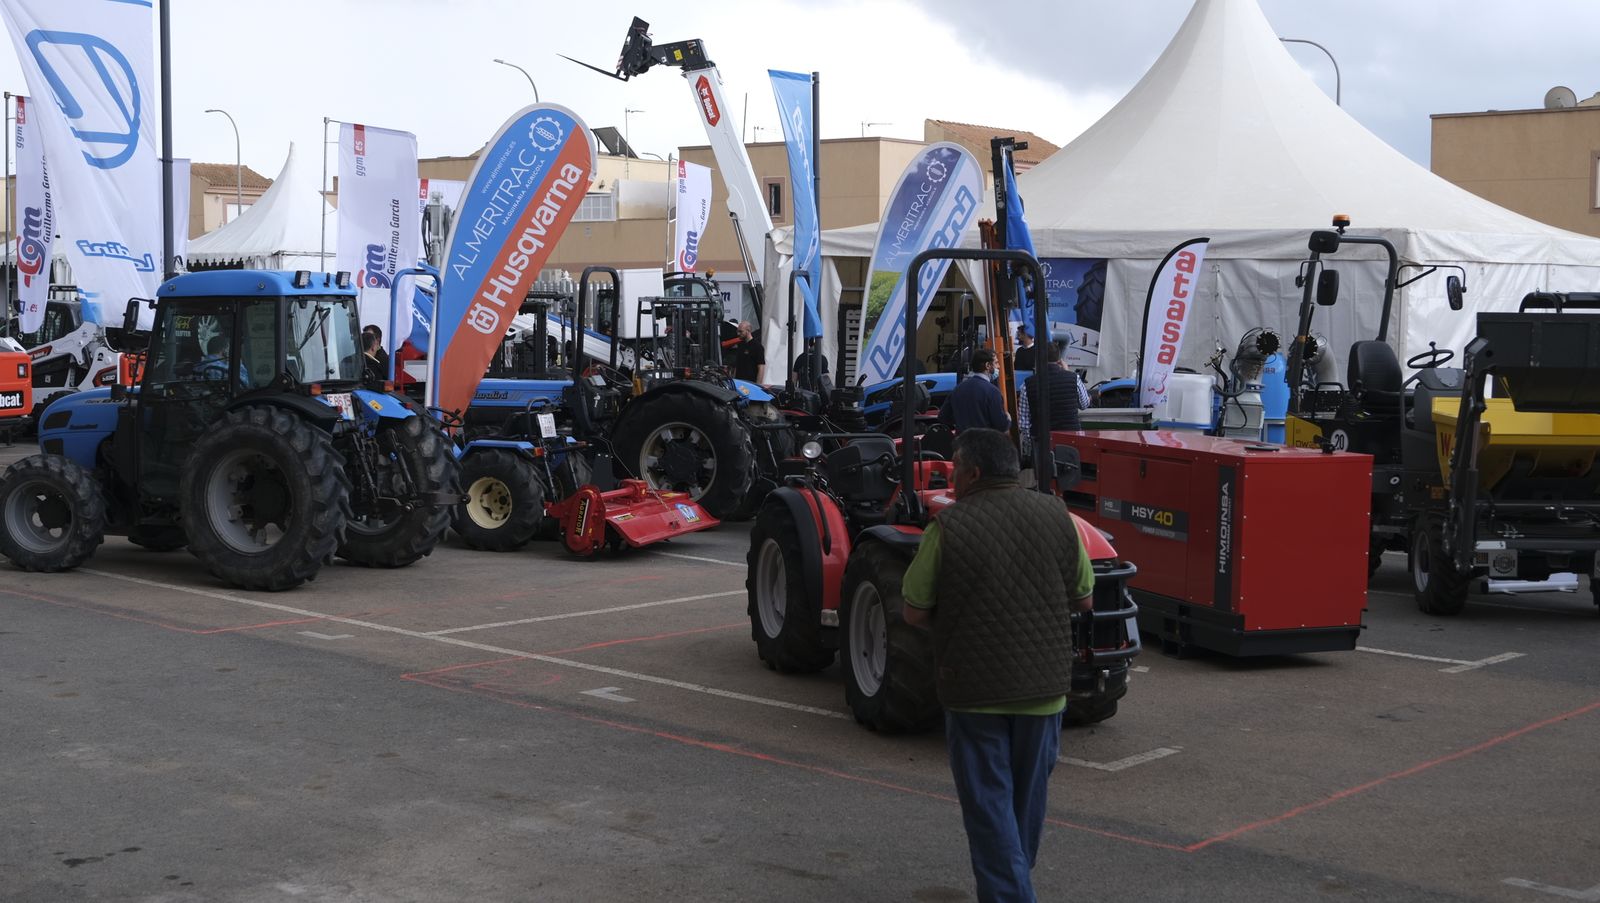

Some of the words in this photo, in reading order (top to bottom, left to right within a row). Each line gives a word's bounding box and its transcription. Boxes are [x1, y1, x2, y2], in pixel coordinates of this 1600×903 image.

[43, 191, 51, 243] Guillermo
[453, 148, 537, 281] ALMERITRAC
[482, 163, 583, 307] Husqvarna
[502, 190, 526, 226] MAQUINARIA
[885, 182, 932, 267] ALMERITRAC
[387, 231, 400, 275] Guillermo
[1156, 250, 1197, 365] atasa
[0, 393, 21, 408] bcat
[1334, 433, 1345, 451] 20
[1218, 482, 1230, 574] HIMOINSA
